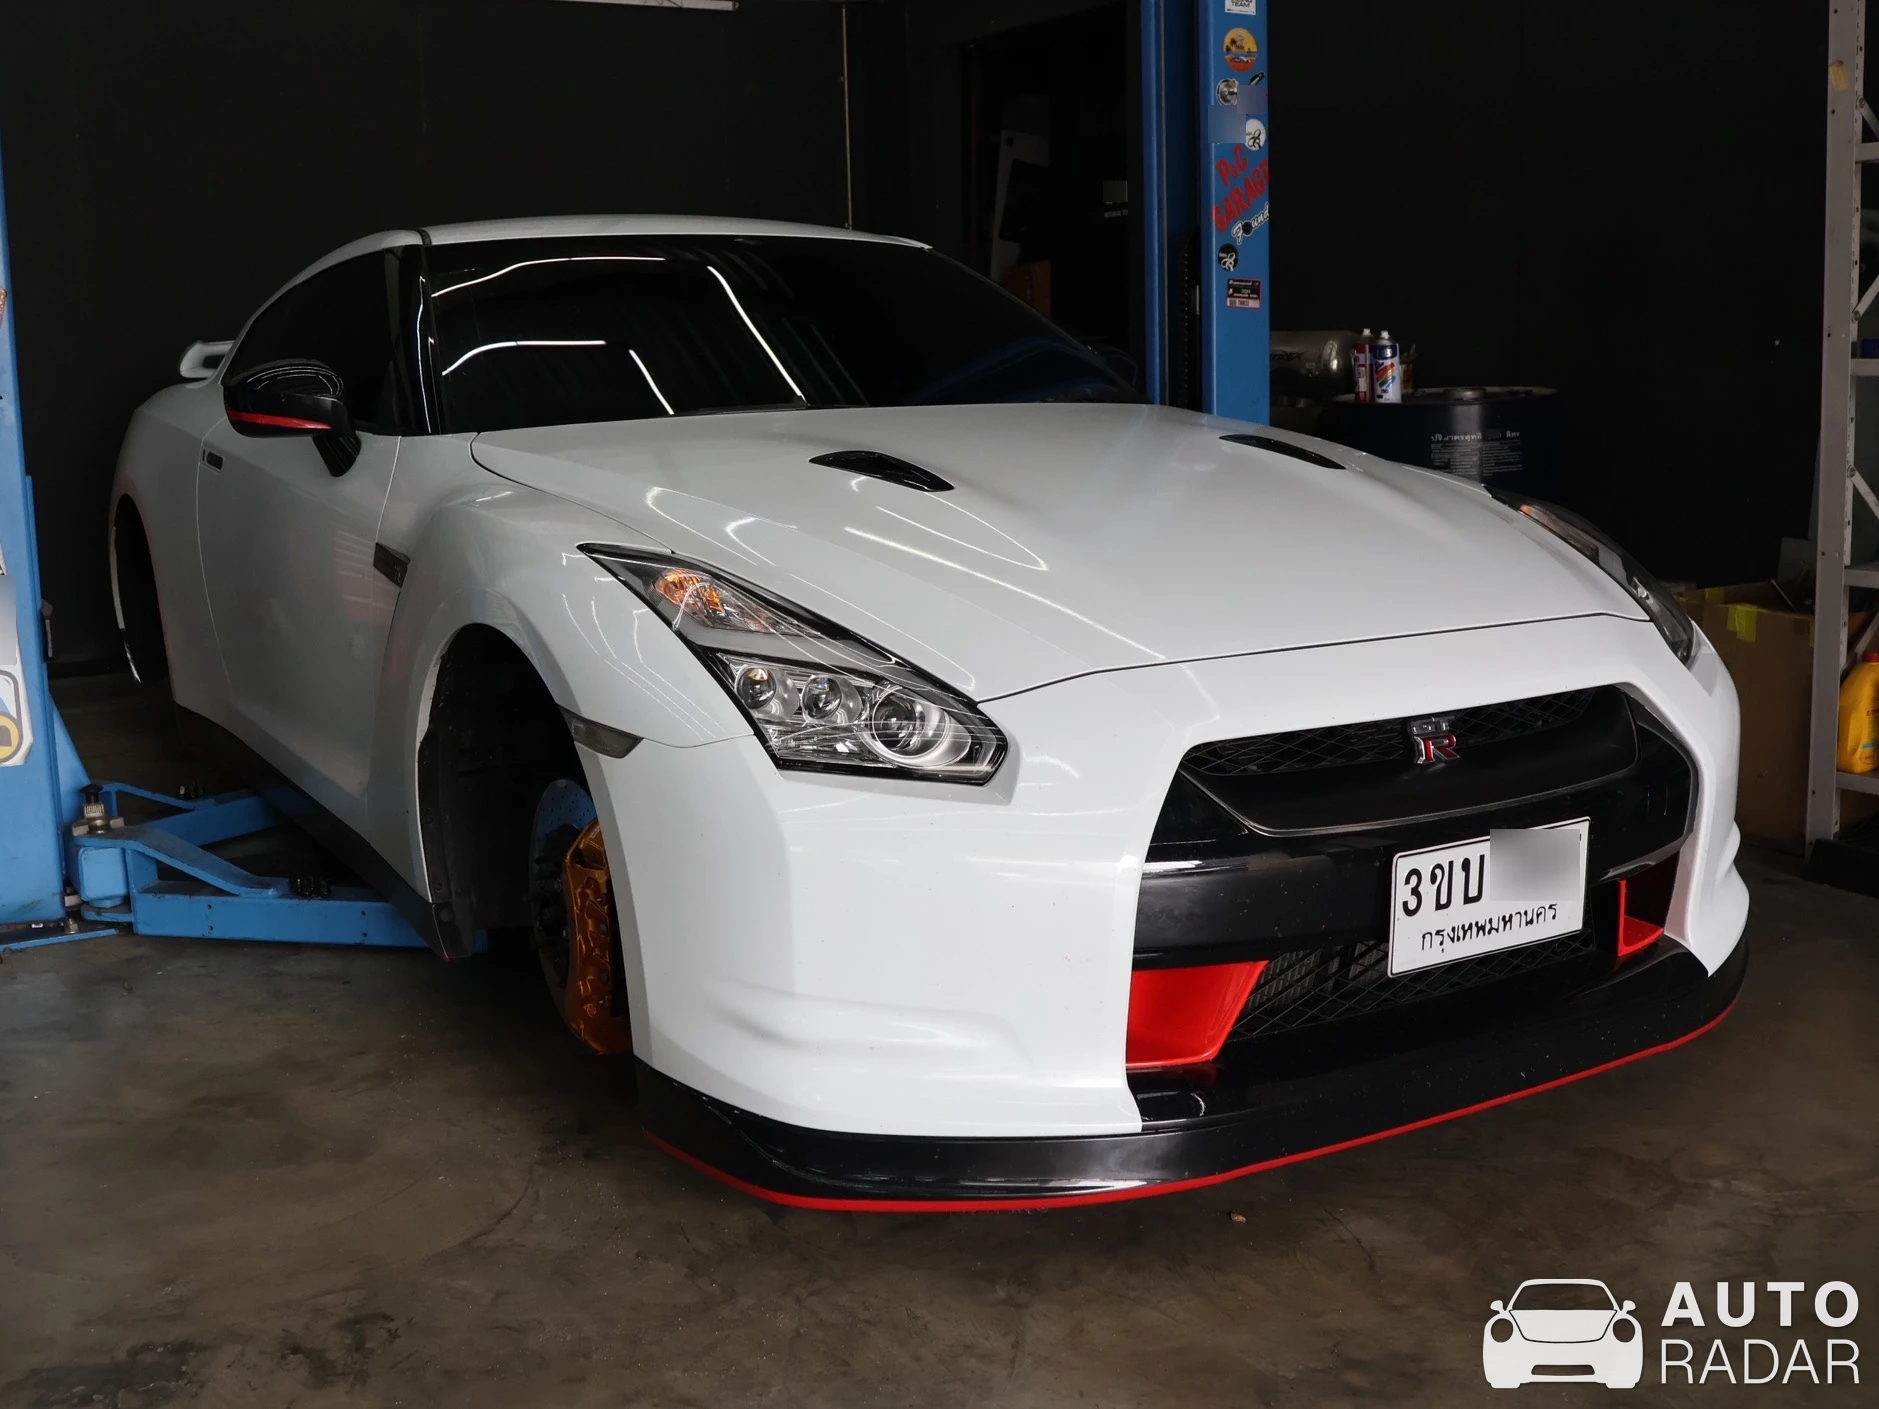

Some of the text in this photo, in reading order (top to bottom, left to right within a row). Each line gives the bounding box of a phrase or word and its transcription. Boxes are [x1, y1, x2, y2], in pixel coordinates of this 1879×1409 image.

[1421, 903, 1558, 953] กรุงเทพมหานคร
